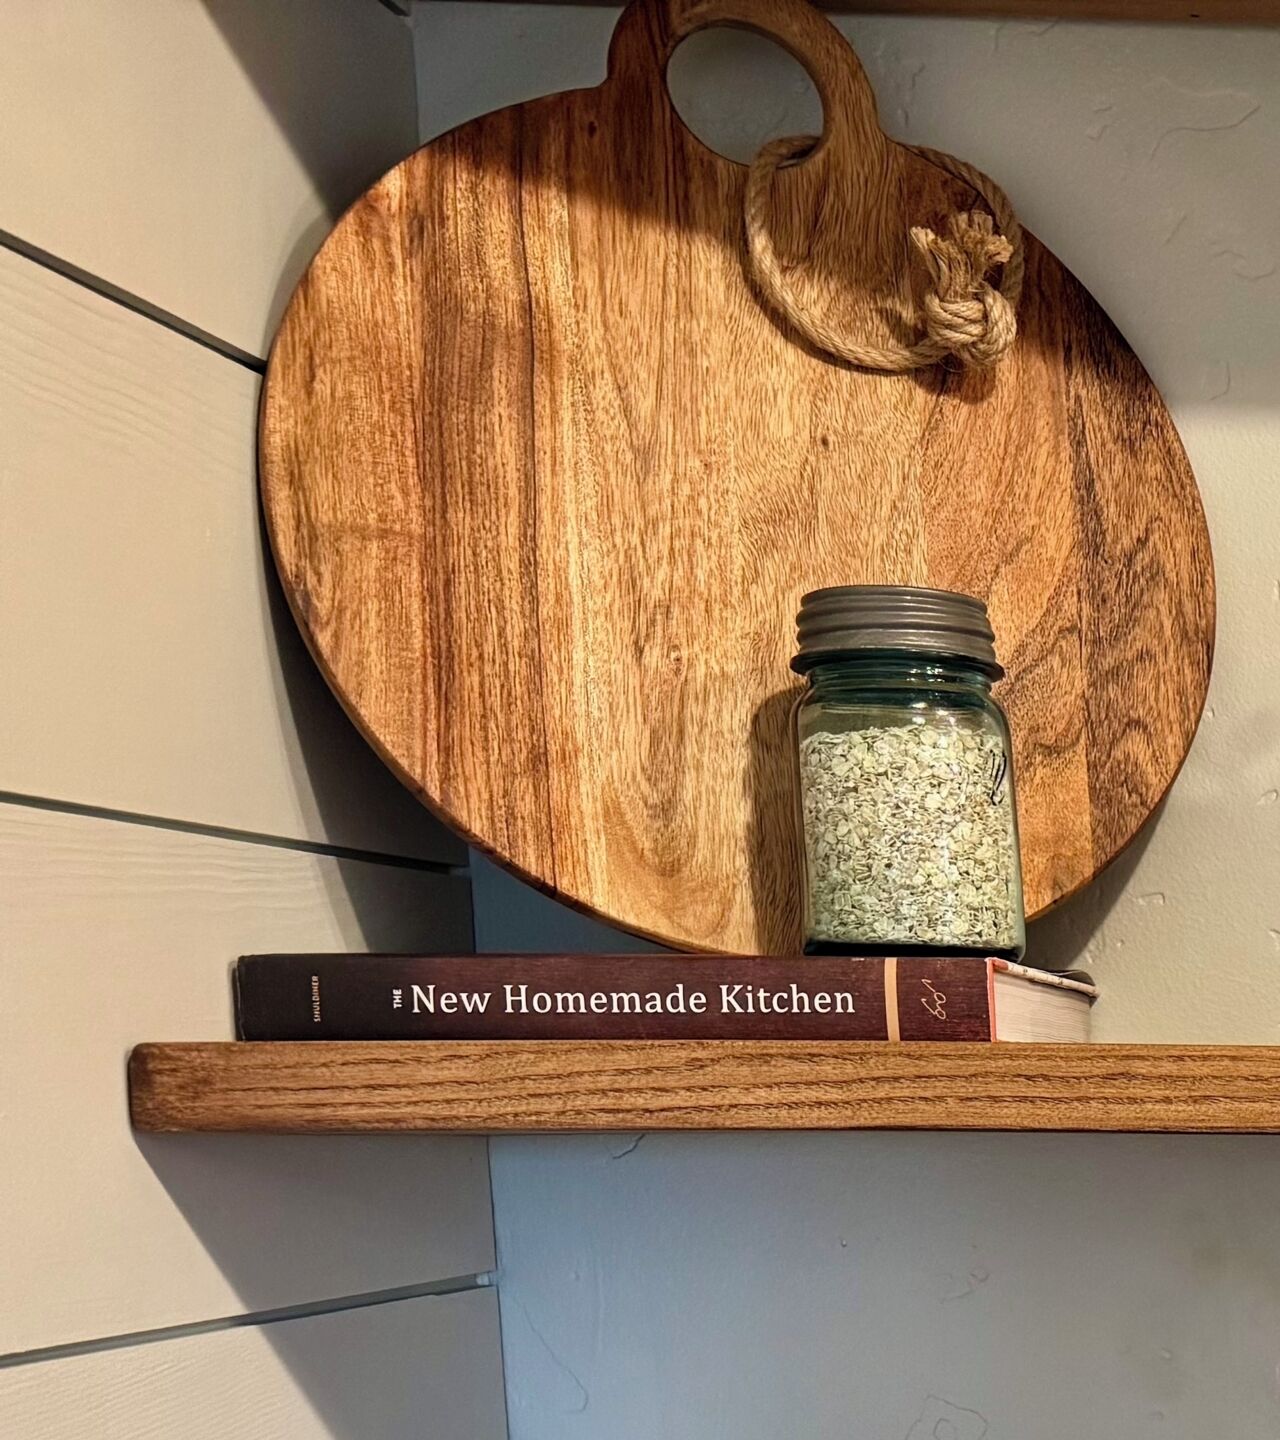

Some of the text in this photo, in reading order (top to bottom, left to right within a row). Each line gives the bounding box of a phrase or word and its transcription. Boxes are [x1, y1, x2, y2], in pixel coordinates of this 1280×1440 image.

[393, 983, 856, 1014] THE New Homemade Kitchen
